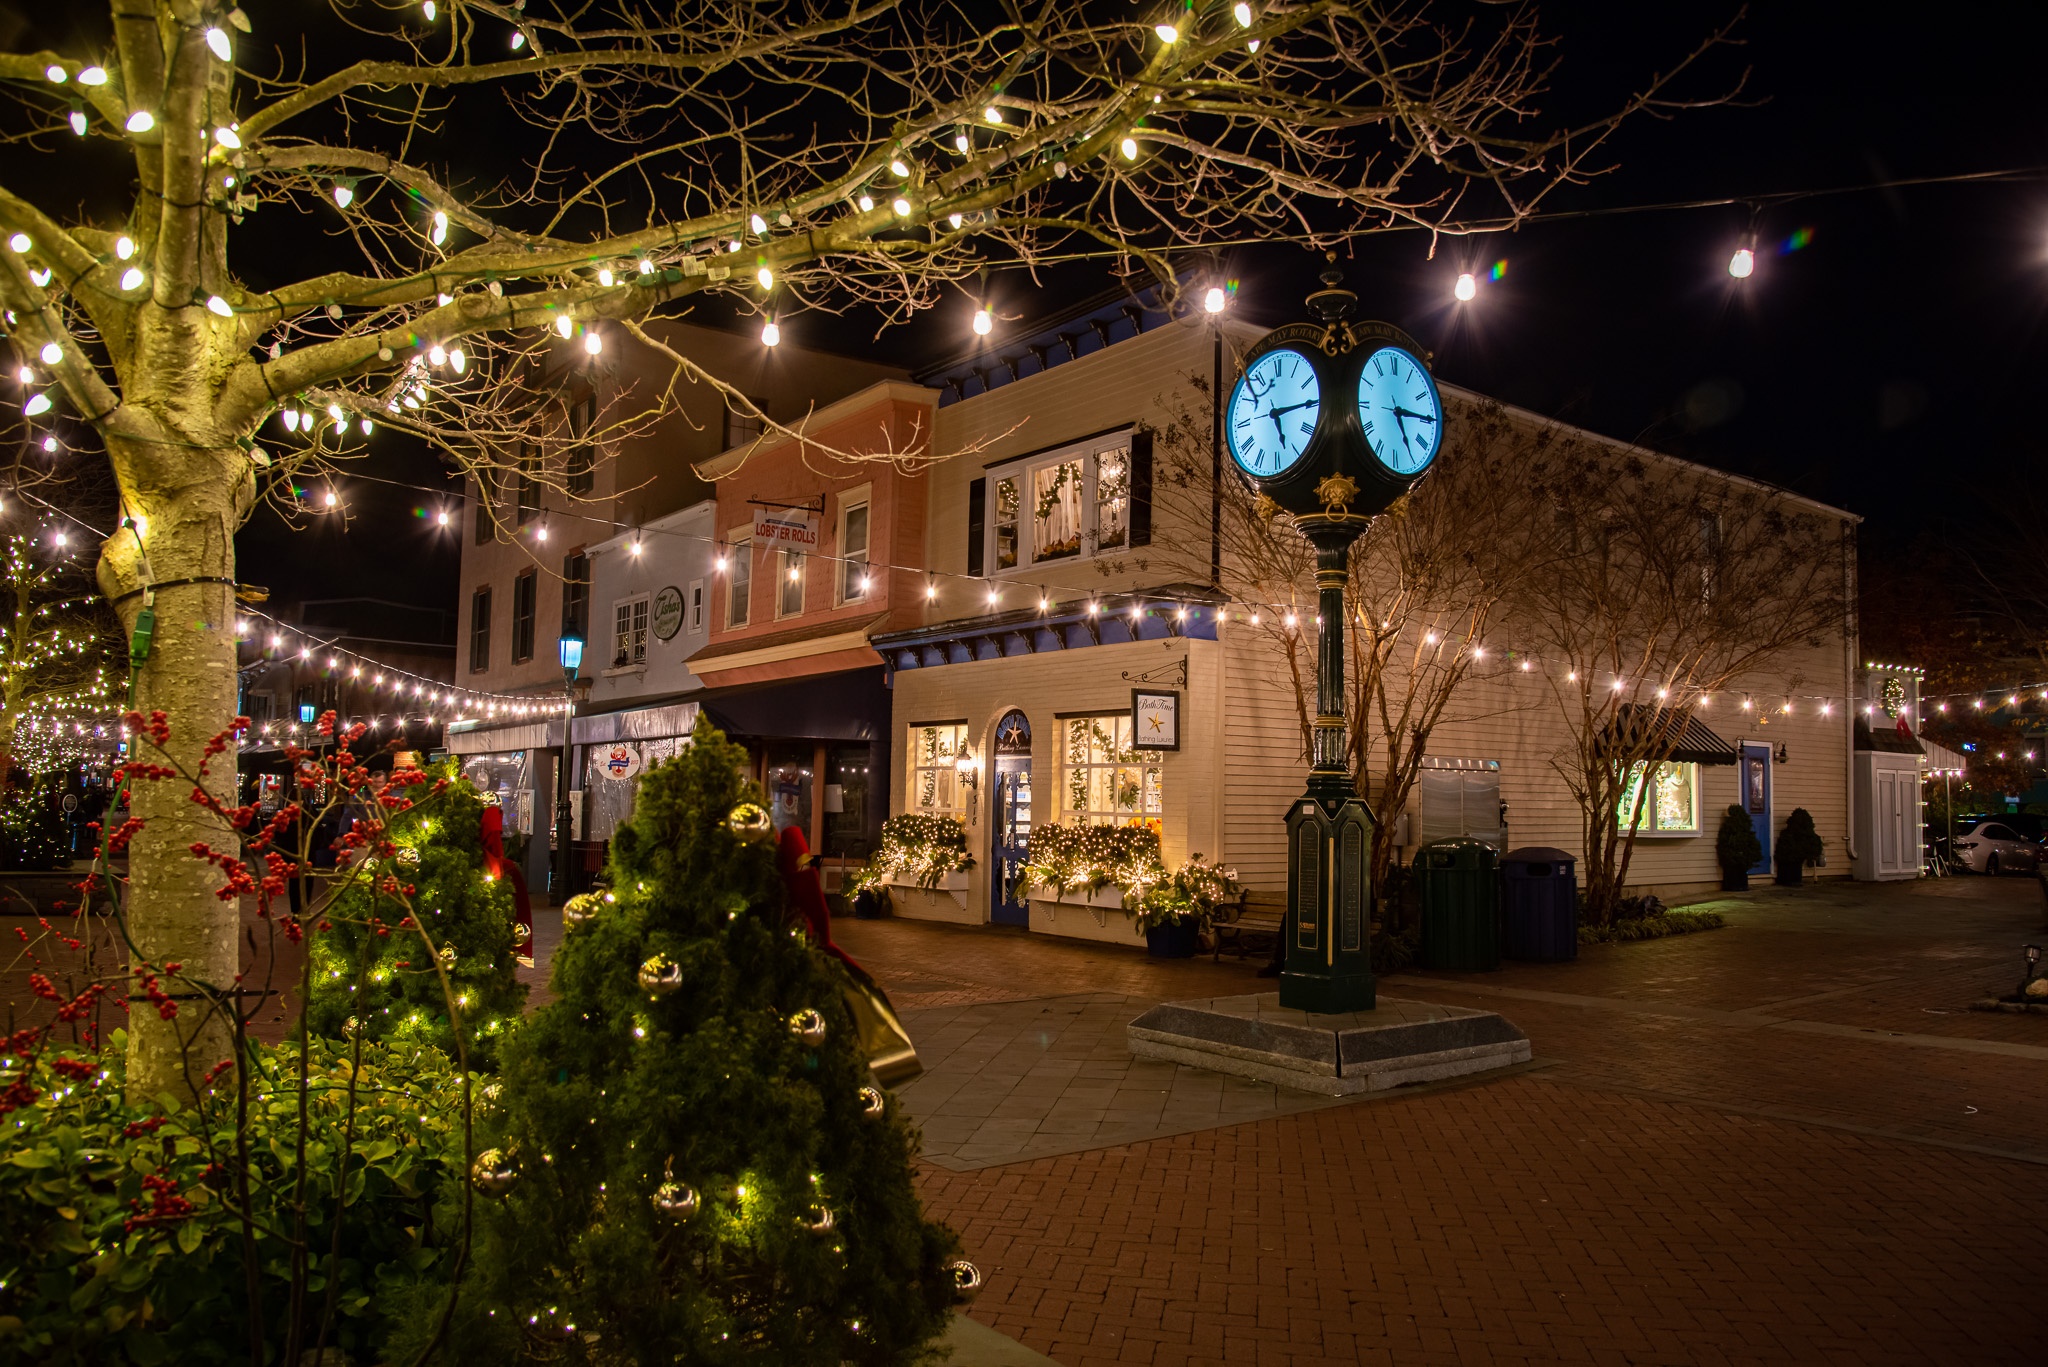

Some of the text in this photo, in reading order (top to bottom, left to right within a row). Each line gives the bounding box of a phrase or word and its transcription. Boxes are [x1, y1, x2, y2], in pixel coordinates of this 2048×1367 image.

[1373, 325, 1393, 338] MAY
[1244, 327, 1323, 363] CAPE MAY ROTARY
[756, 523, 790, 541] LOBSTER
[791, 529, 816, 545] ROLLS
[653, 594, 681, 621] Tisha's
[1138, 698, 1174, 712] Bath Time
